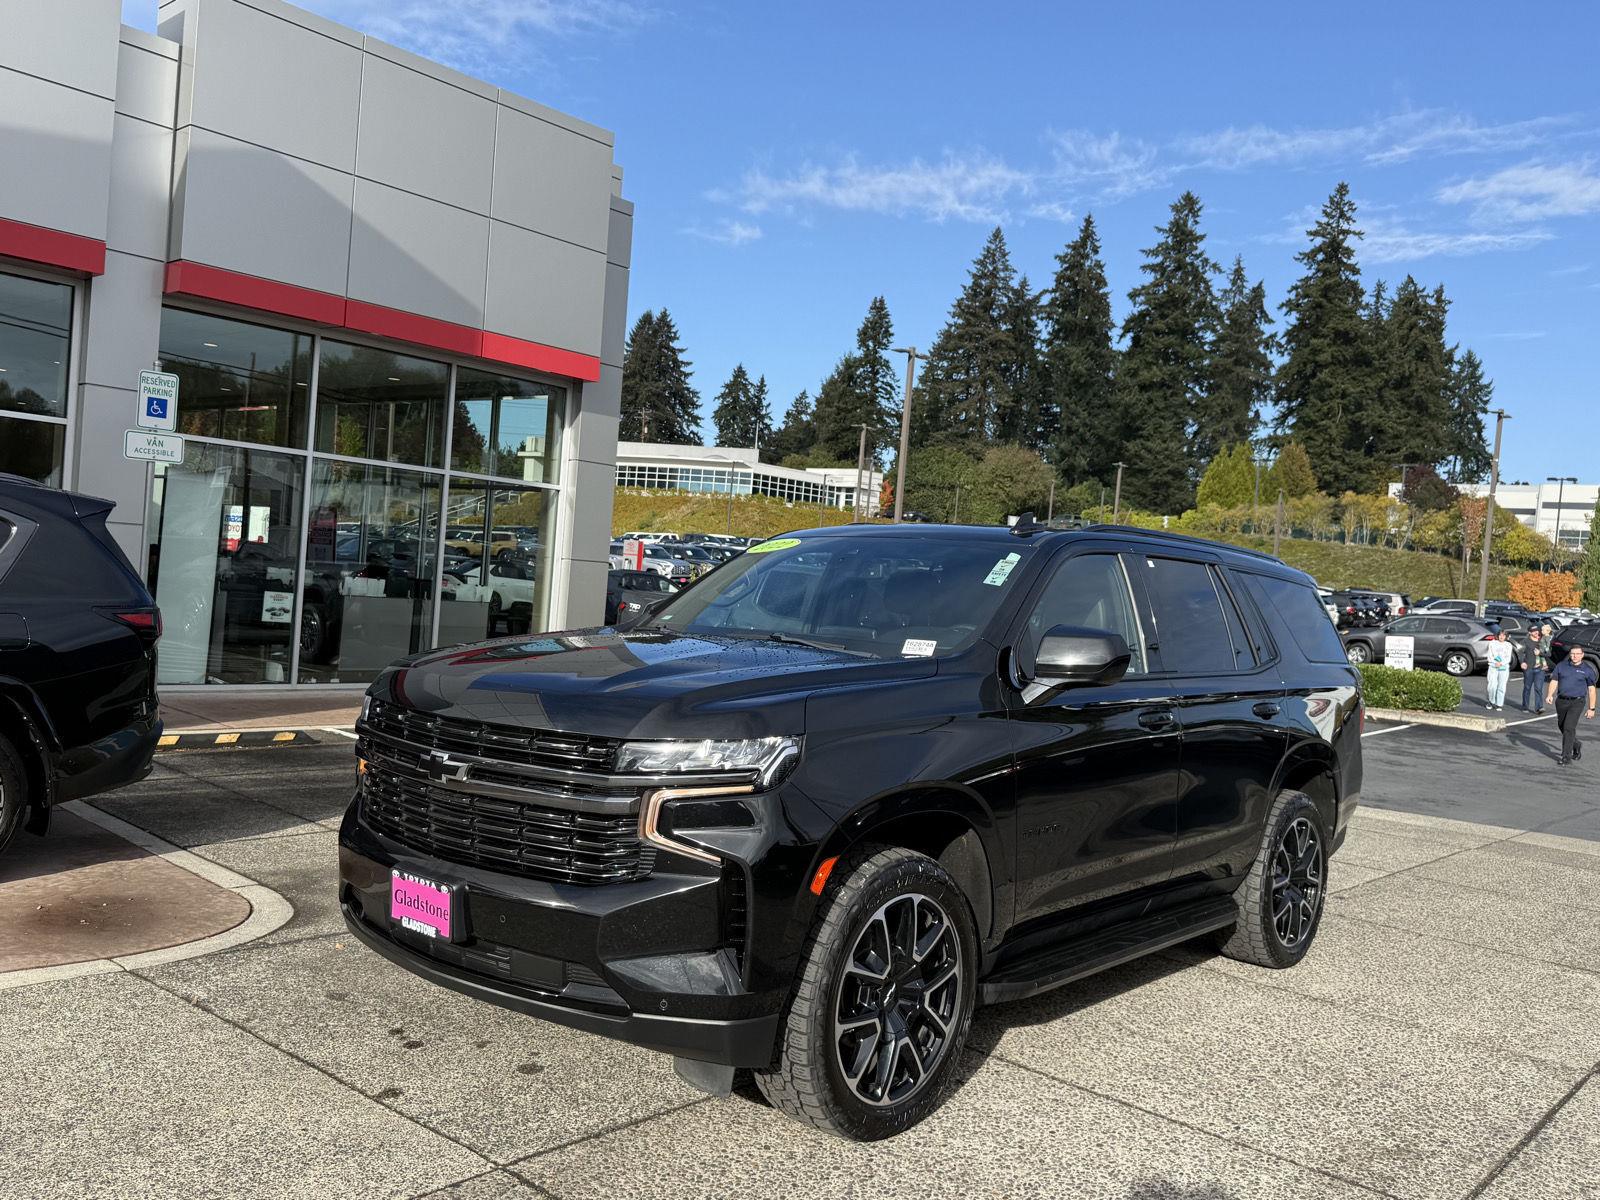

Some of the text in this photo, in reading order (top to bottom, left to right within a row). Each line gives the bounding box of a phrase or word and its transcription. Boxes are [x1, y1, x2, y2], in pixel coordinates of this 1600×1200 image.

[141, 375, 176, 388] RESERVED
[143, 385, 173, 398] PARKING
[146, 437, 164, 447] VAN
[133, 447, 175, 457] ACCESSIBLE
[224, 524, 241, 533] TOYO
[403, 873, 436, 889] TOYOTA
[394, 889, 449, 920] Gladstone
[402, 917, 436, 938] GLADSTONE
